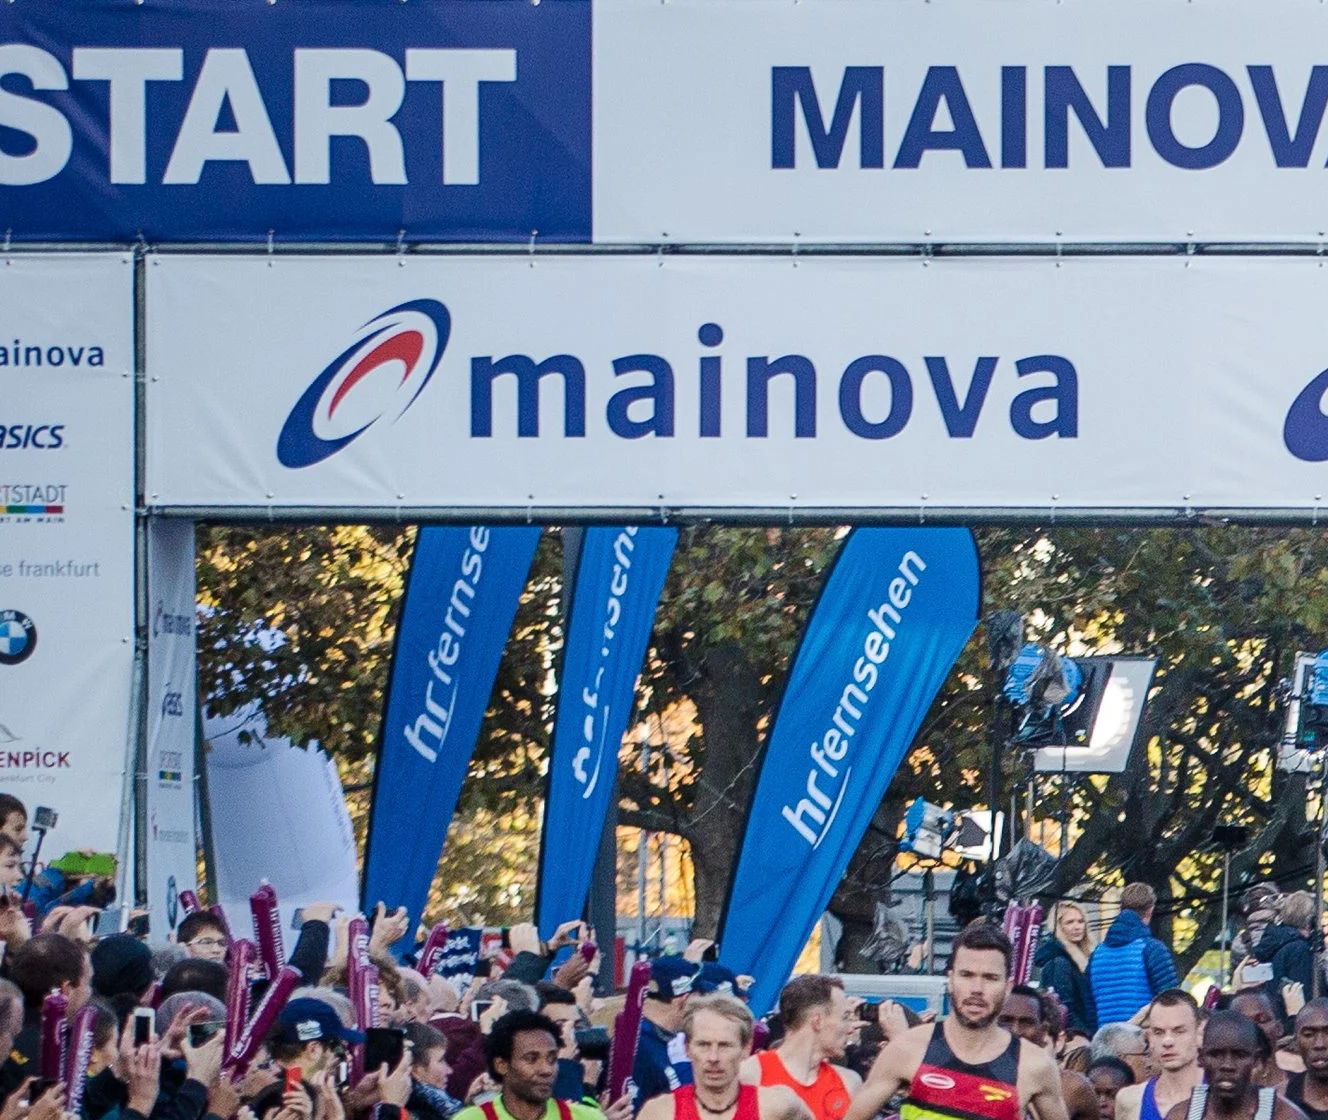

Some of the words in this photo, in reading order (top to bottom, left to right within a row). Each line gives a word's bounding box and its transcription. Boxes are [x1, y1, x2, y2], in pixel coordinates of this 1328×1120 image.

[0, 44, 518, 187] START
[469, 322, 1080, 441] mainova
[19, 559, 101, 577] frankfurt
